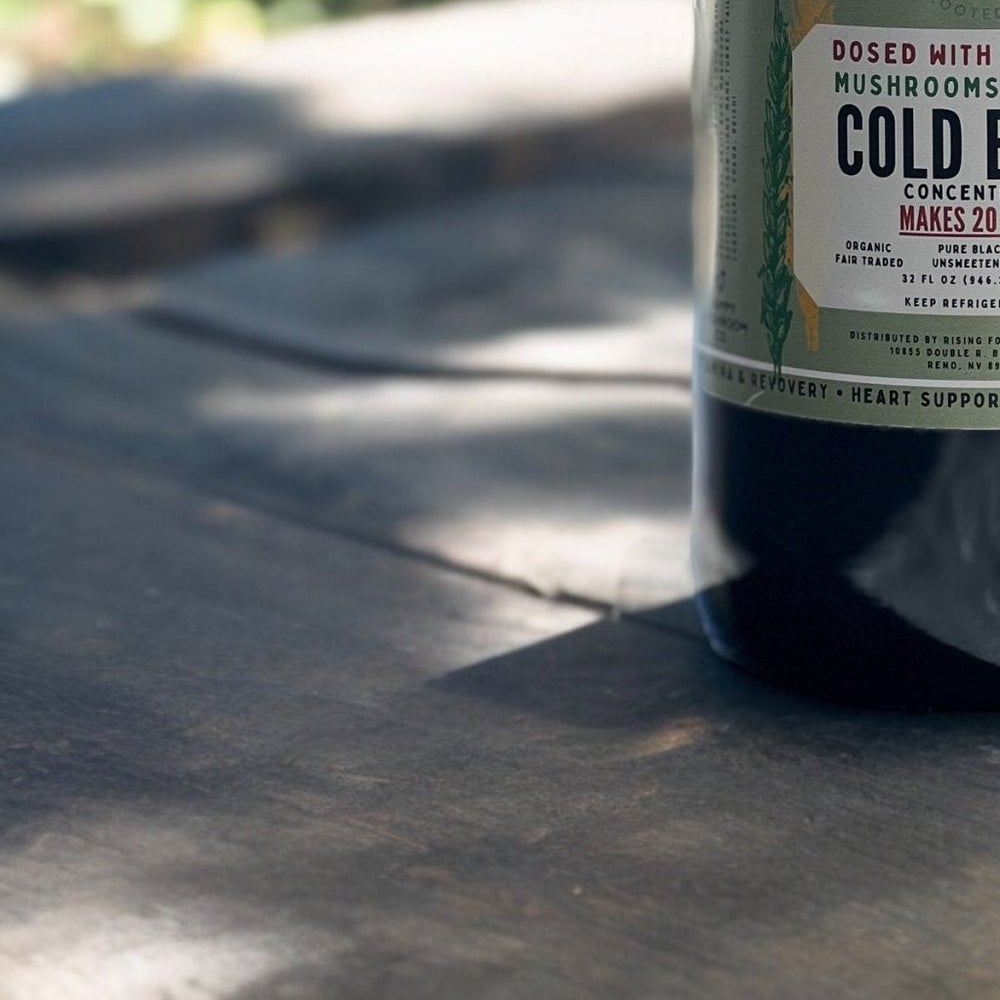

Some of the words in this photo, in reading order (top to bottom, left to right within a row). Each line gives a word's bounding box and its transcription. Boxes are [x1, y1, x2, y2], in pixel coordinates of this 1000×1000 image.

[832, 40, 916, 65] DOSED
[929, 43, 992, 66] WITH
[834, 72, 999, 98] MUSHROOMS
[837, 103, 963, 180] COLD
[900, 205, 965, 232] MAKES
[972, 206, 997, 233] 20
[845, 240, 892, 253] ORGANIC
[938, 244, 967, 254] PURE
[835, 254, 859, 266] FAIR
[862, 255, 904, 268] TRADED
[902, 273, 916, 284] 32
[921, 274, 934, 285] FL
[941, 274, 957, 285] OZ
[904, 297, 937, 308] KEEP
[850, 331, 919, 343] DISTRIBUTED
[925, 335, 938, 345] BY
[943, 336, 982, 345] RISING
[926, 348, 970, 357] DOUBLE
[927, 361, 962, 371] RENO,
[968, 361, 982, 370] NV
[852, 386, 911, 407] HEART
